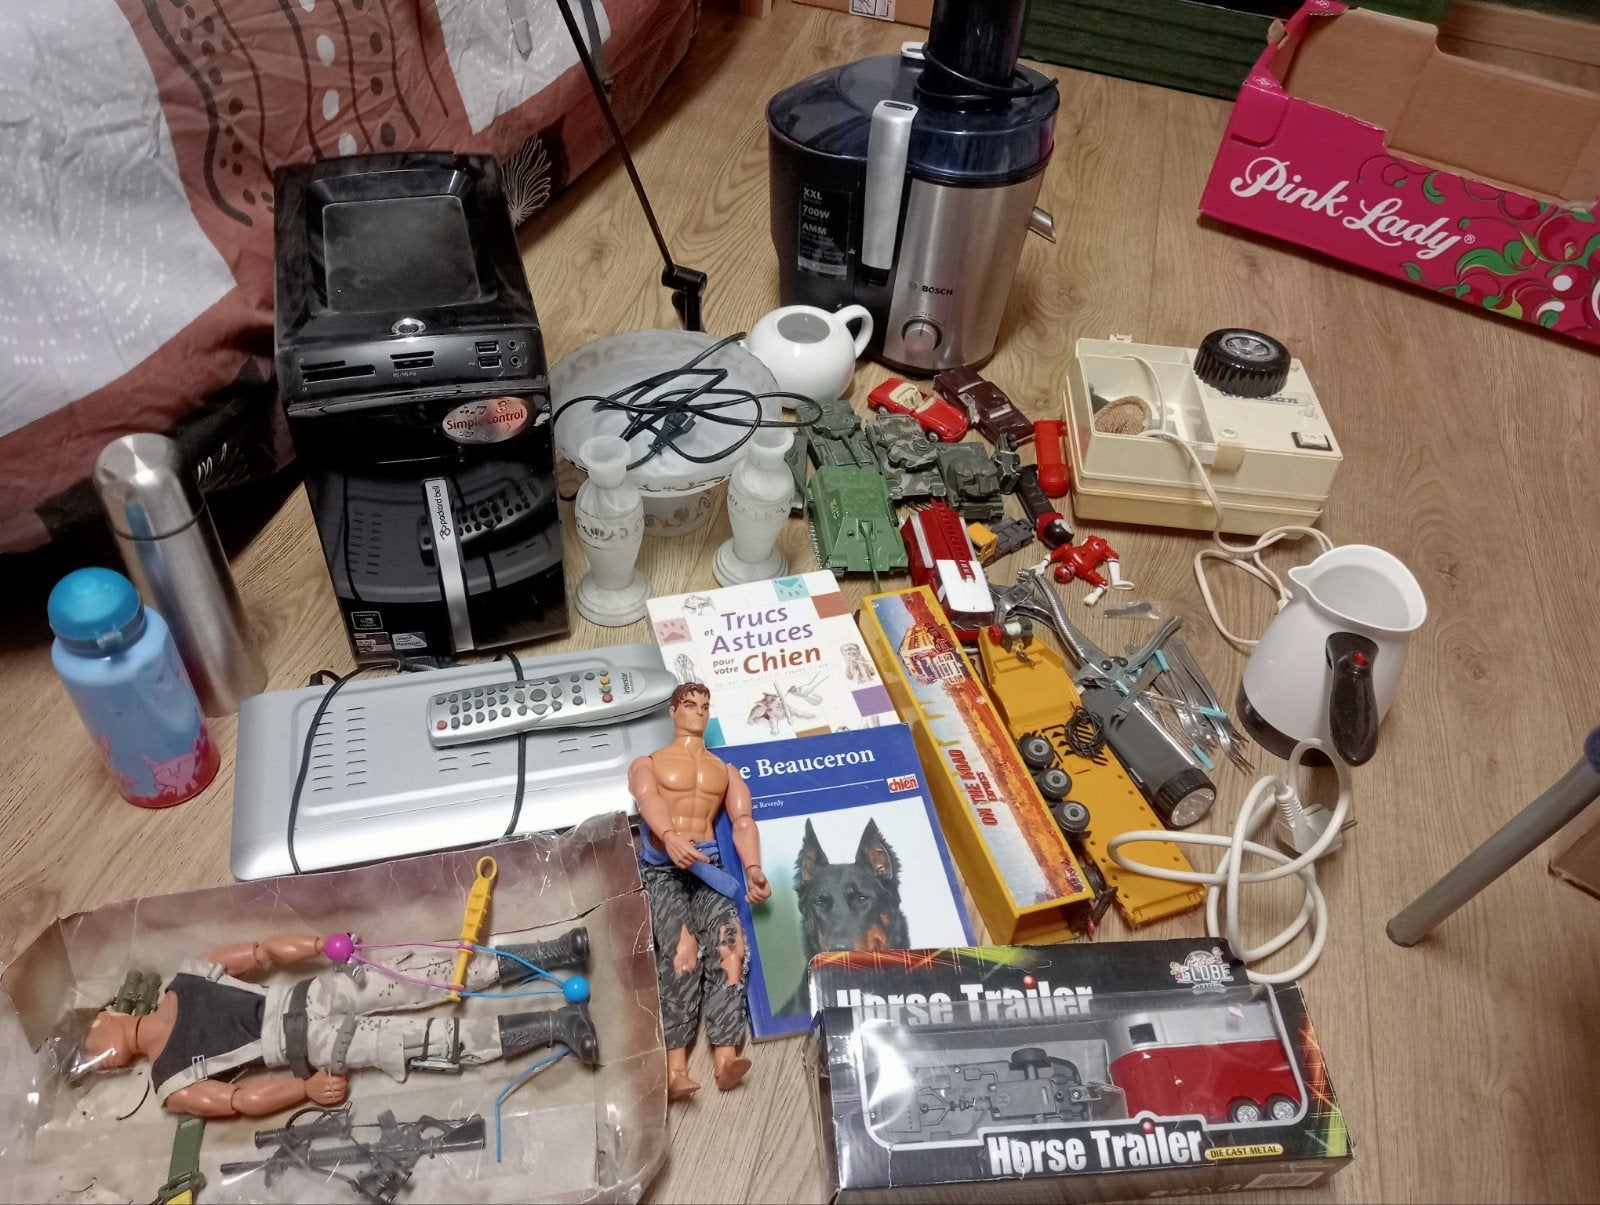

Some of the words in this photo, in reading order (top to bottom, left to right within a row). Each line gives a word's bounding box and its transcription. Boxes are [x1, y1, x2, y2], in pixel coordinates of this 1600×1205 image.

[803, 187, 824, 201] XXL
[802, 204, 831, 219] 700W
[1230, 156, 1350, 217] Pink
[1342, 197, 1462, 260] Lady
[801, 221, 828, 236] AMM
[922, 285, 954, 296] BOSCH
[446, 416, 483, 430] Simple
[432, 485, 442, 497] bell
[720, 607, 788, 631] Trucs
[704, 628, 715, 637] et
[710, 623, 813, 655] Astuces
[713, 658, 735, 669] pour
[714, 666, 739, 675] votre
[743, 646, 821, 675] Chien
[739, 766, 751, 780] e
[756, 748, 876, 779] Beauceron
[948, 749, 977, 780] ROAD
[759, 799, 784, 809] Reverdy
[964, 783, 988, 806] THE
[976, 808, 999, 826] ON
[1180, 963, 1235, 983] GLOBE
[836, 988, 953, 1027] Horse
[960, 976, 1094, 1022] Trailer
[987, 1134, 1088, 1177] Horse
[1090, 1121, 1203, 1170] Trailer
[1210, 1149, 1224, 1158] DIE
[1225, 1147, 1247, 1156] CAST
[1249, 1145, 1278, 1154] METAL
